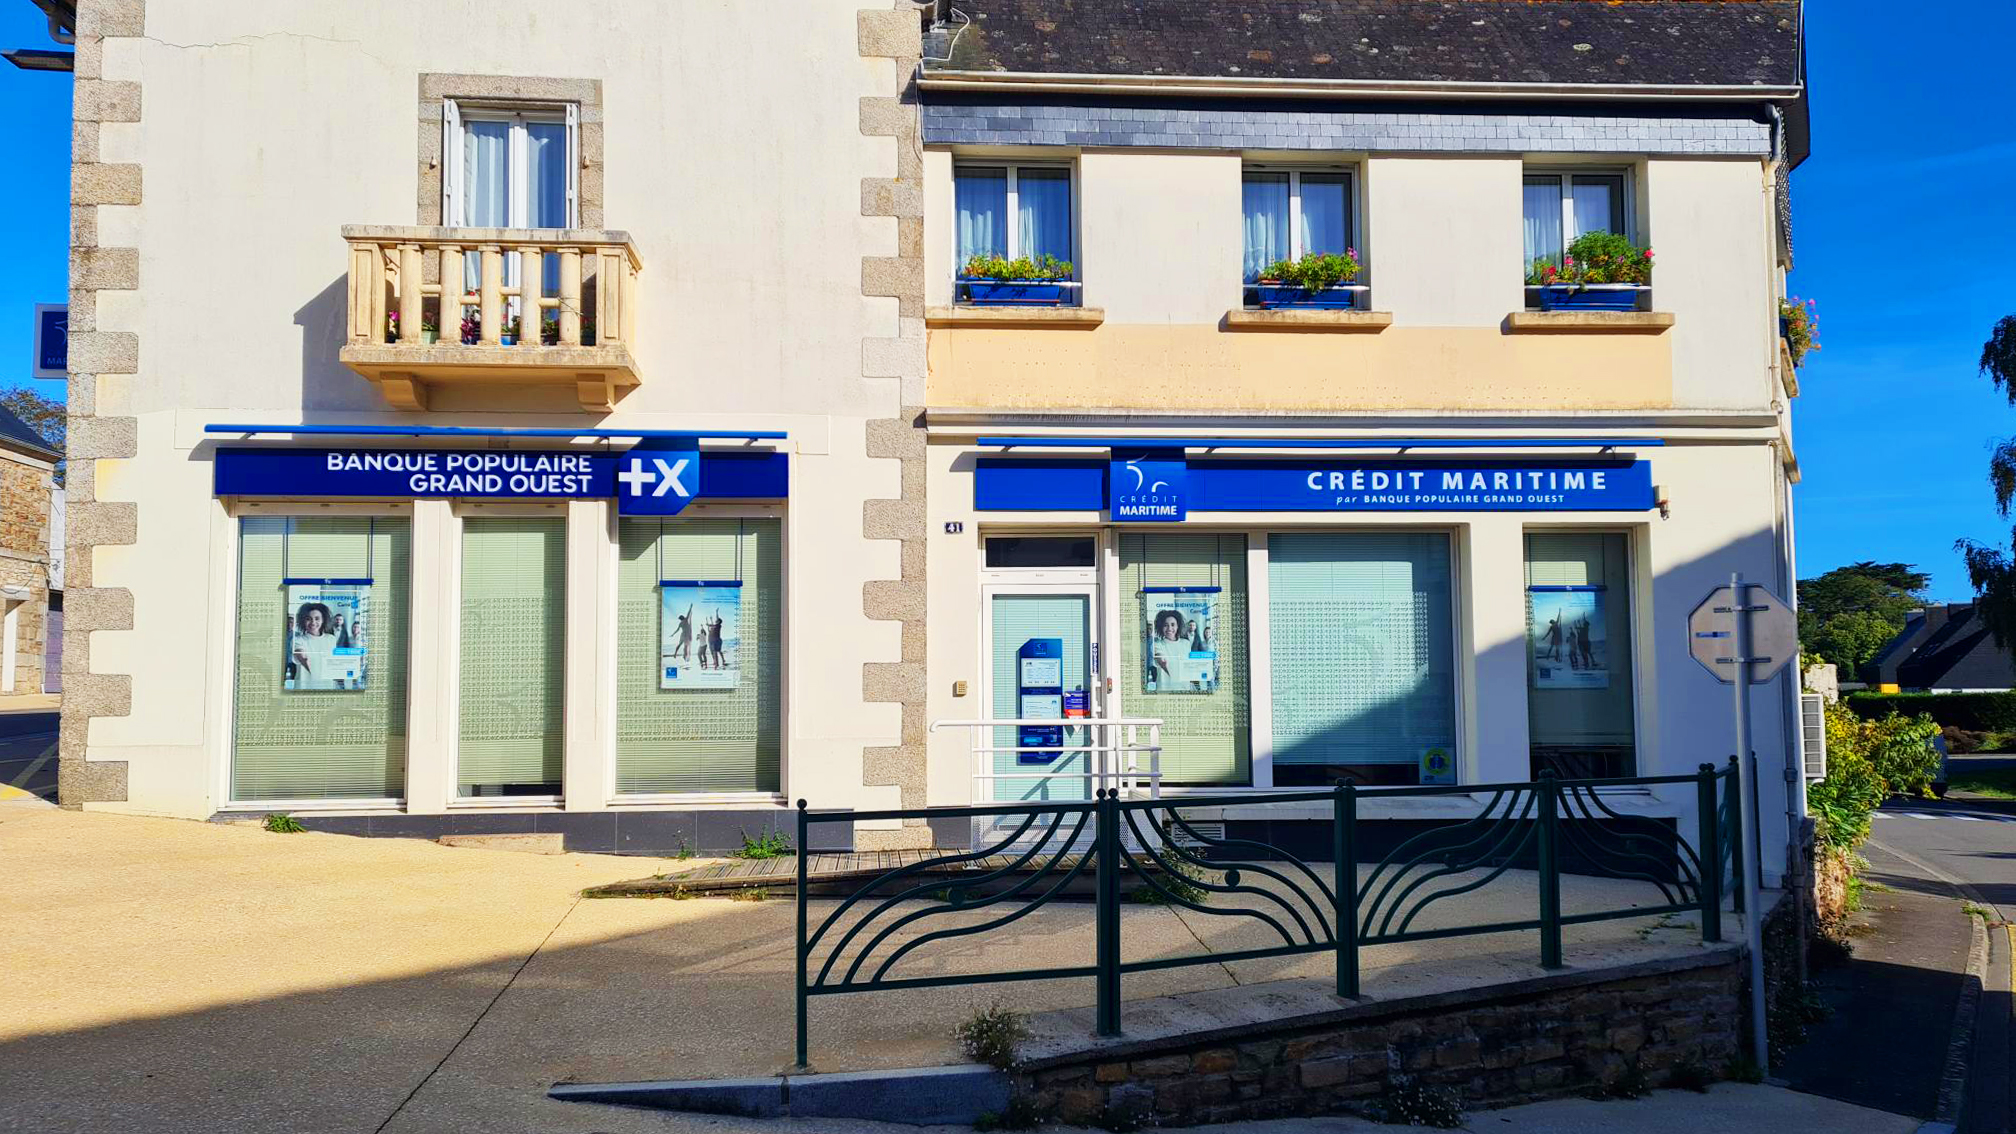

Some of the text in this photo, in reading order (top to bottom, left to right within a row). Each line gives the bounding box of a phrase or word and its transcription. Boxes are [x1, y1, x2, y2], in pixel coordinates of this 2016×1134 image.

[327, 453, 593, 472] BANQUE POPULAIRE
[409, 474, 593, 493] GRAND OUEST
[1307, 469, 1606, 490] CRÉDIT MARITIME
[1119, 494, 1178, 503] CRÉDIT
[1336, 495, 1565, 505] par BANQUE POPULAIRE GRAND OUEST
[1119, 506, 1177, 516] MARITIME
[947, 523, 960, 533] 41
